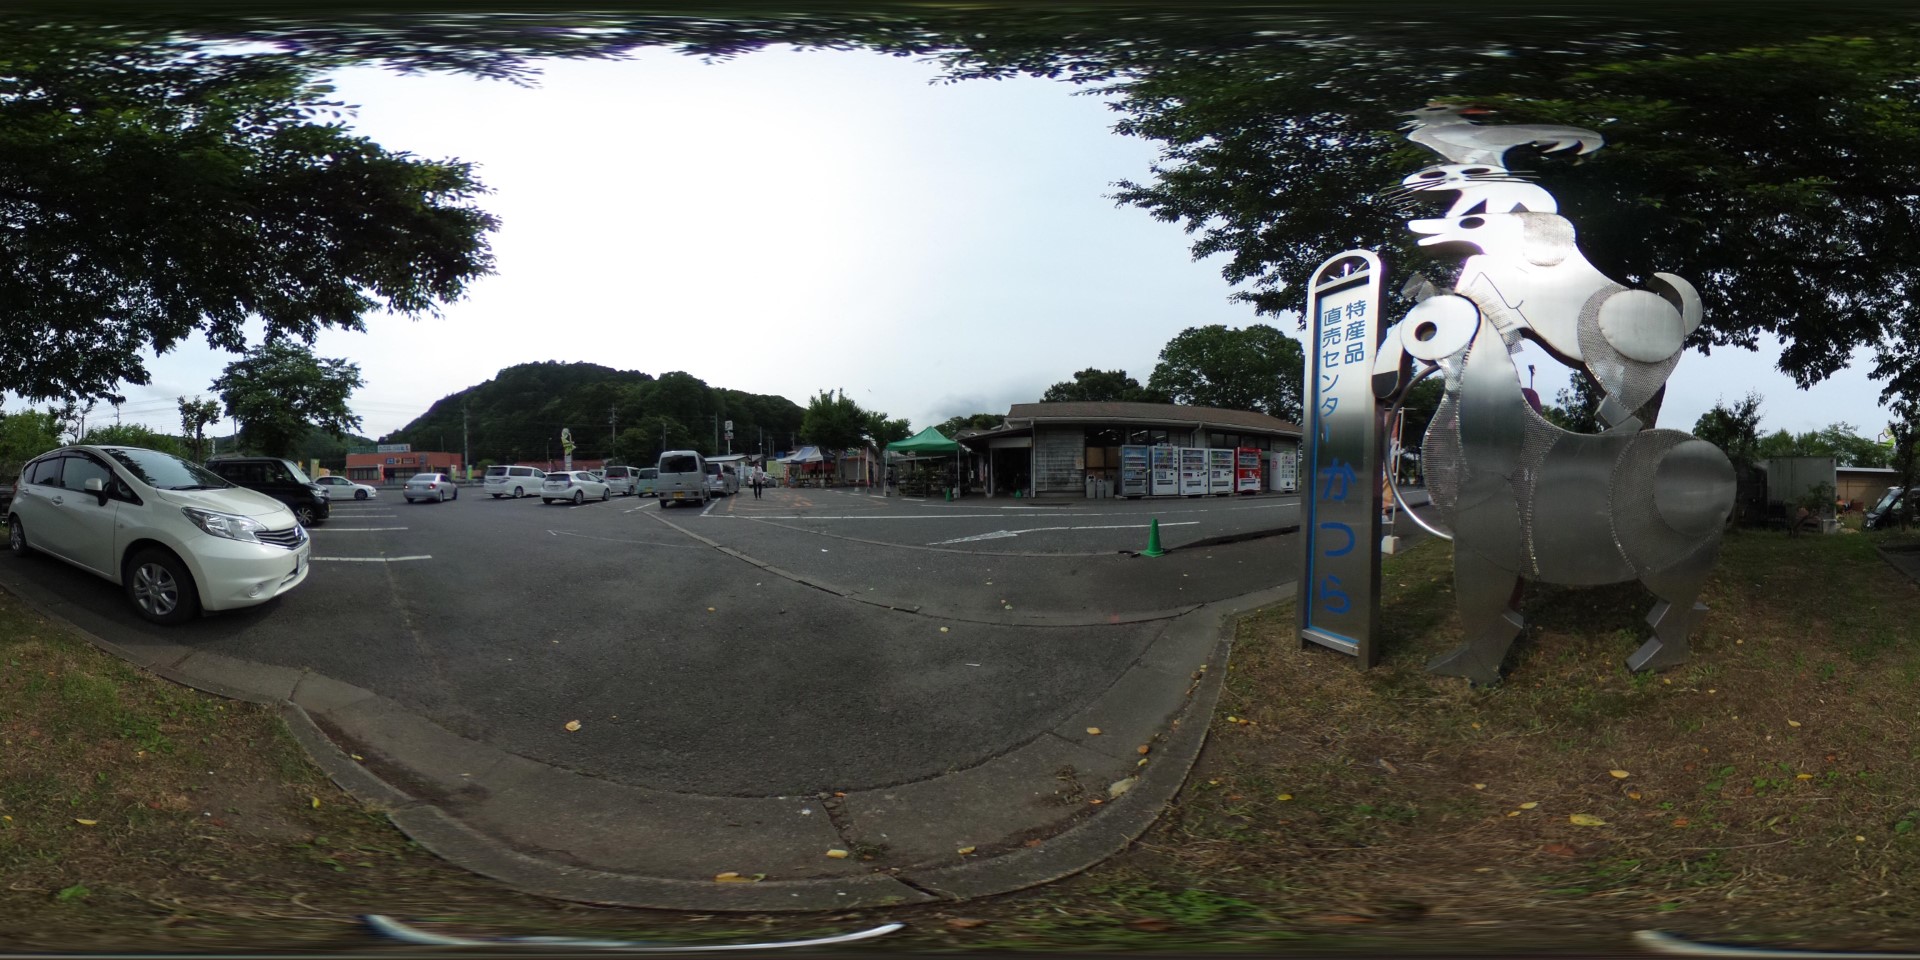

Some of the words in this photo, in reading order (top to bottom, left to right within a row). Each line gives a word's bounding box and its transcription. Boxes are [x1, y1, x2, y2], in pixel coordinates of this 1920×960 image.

[1321, 306, 1343, 443] 直売センター
[1345, 300, 1366, 365] 特産品
[1320, 457, 1358, 614] かつら
